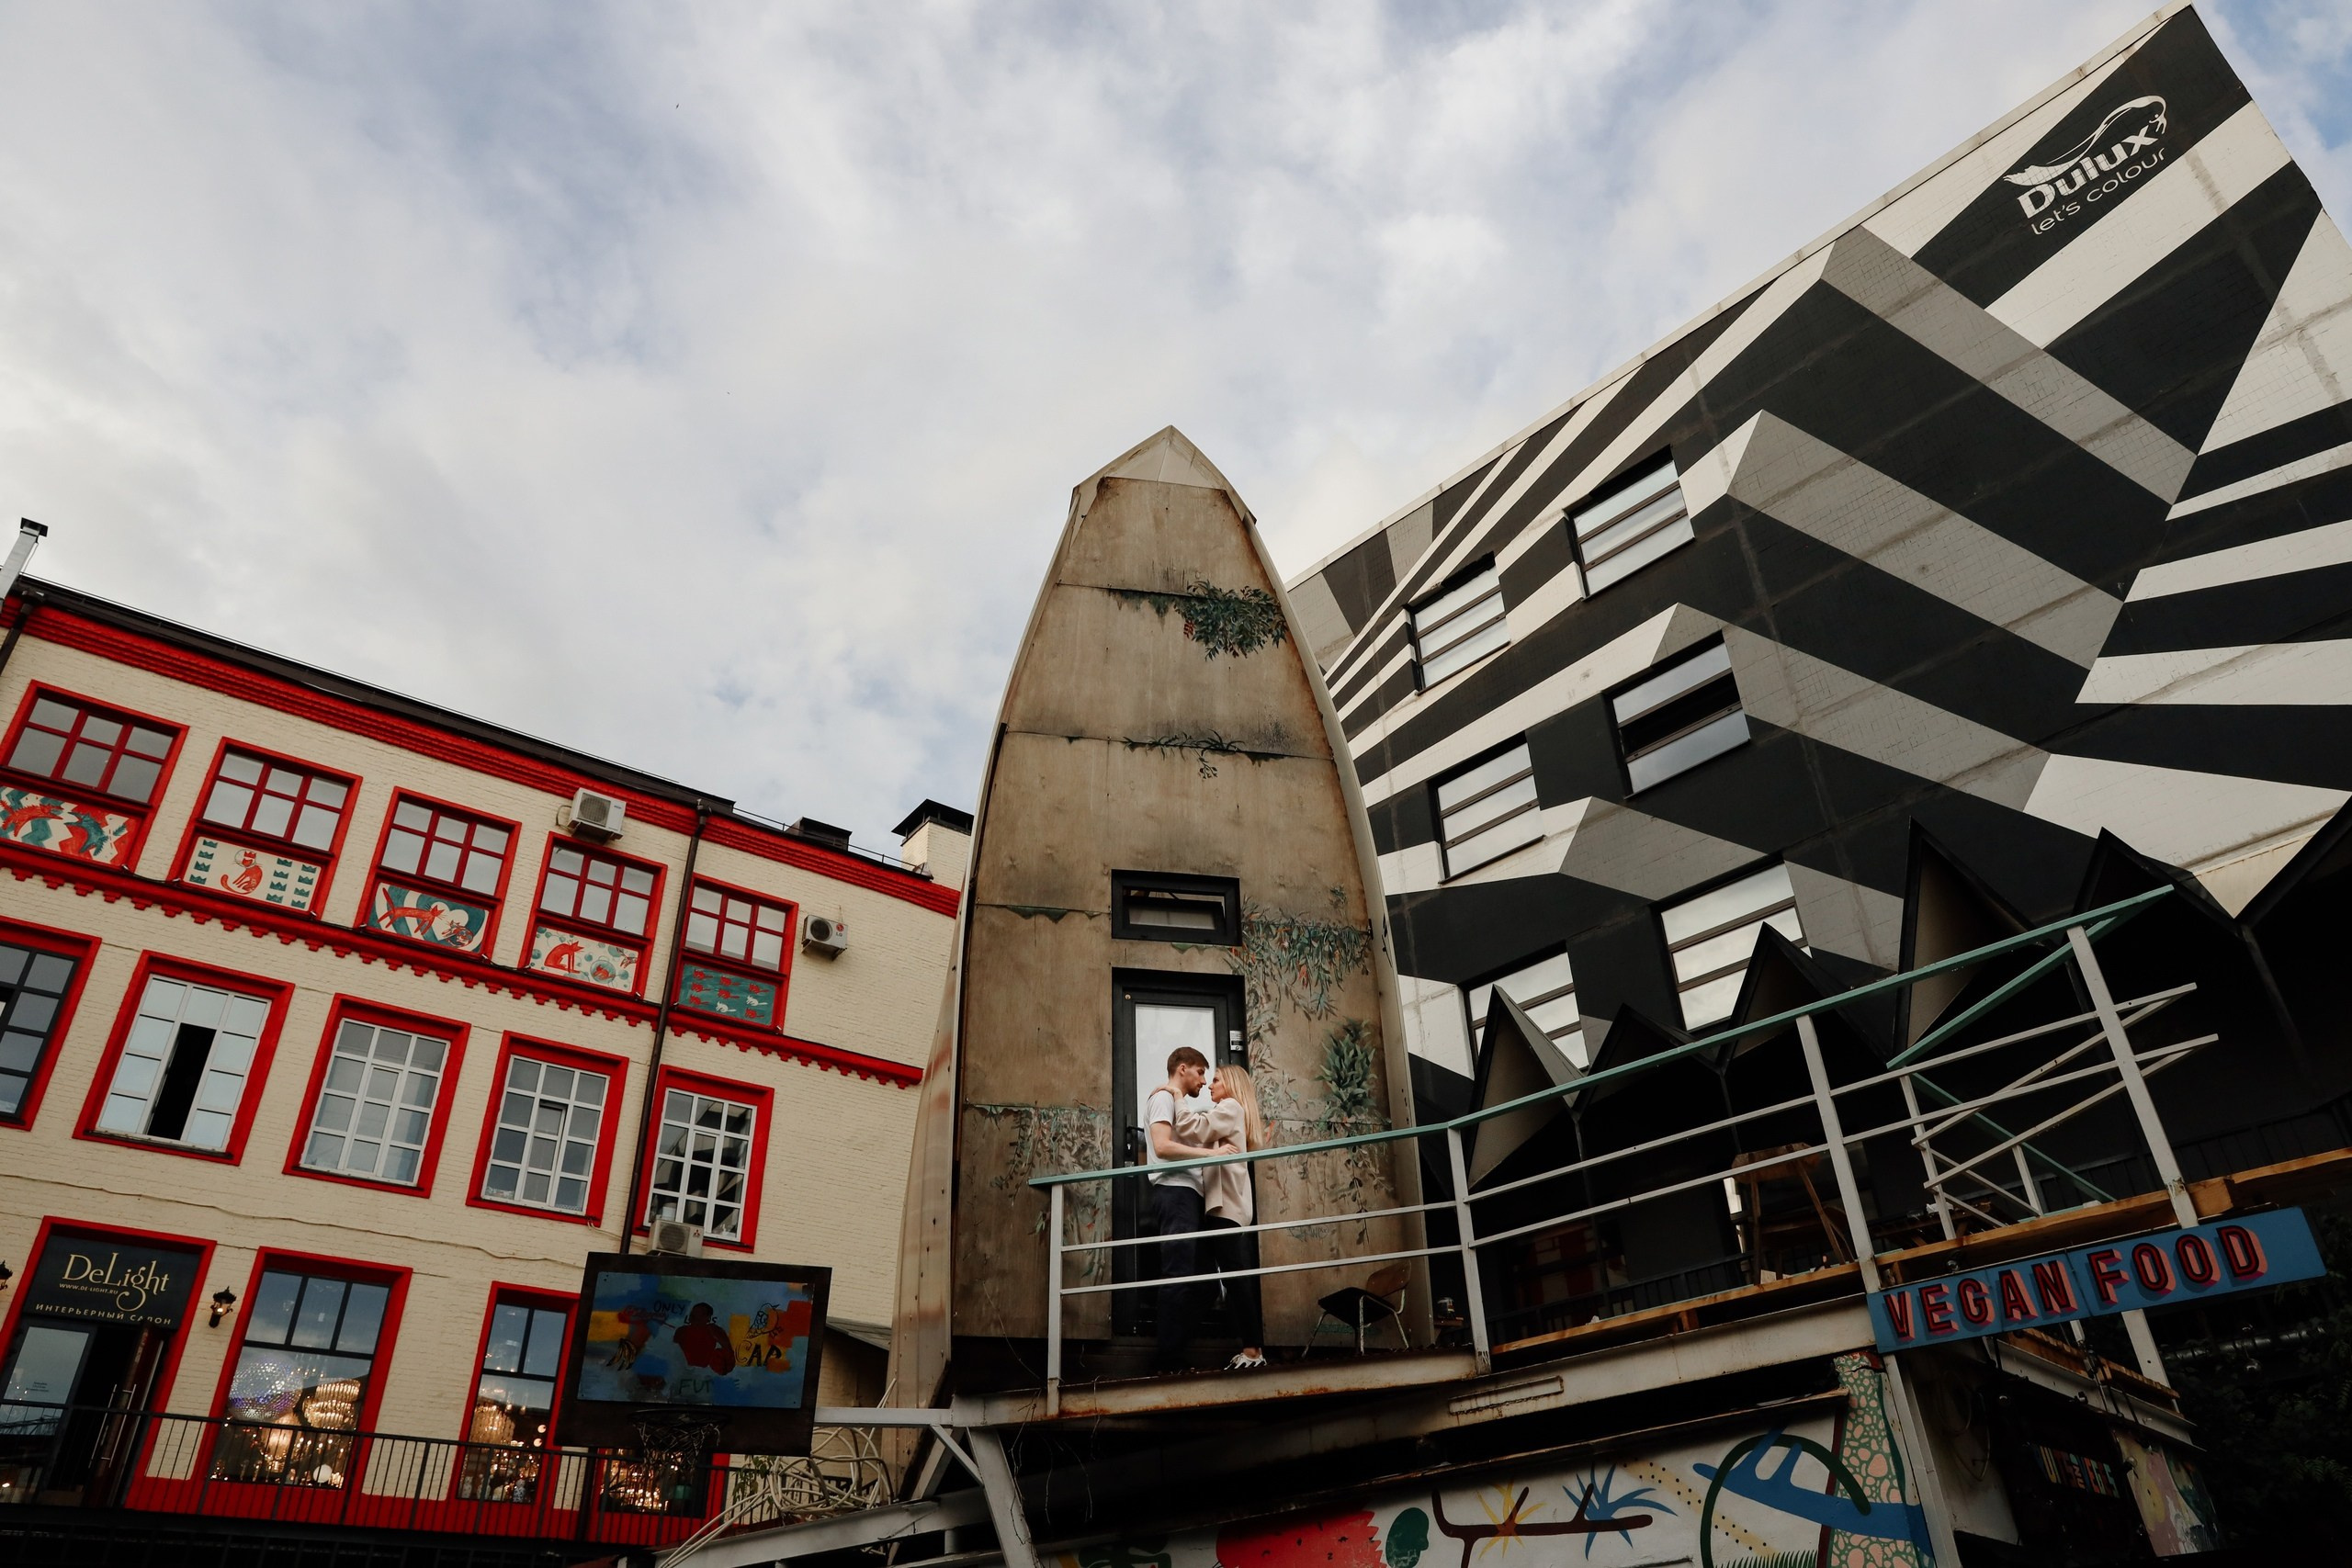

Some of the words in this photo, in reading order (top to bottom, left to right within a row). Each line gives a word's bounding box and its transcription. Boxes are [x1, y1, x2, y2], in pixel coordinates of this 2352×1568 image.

[2017, 124, 2159, 219] Dulux
[2031, 201, 2081, 235] let's
[2086, 147, 2165, 202] colour
[36, 1303, 125, 1320] ИНТЕРЬЕРНЫЙ
[130, 1314, 171, 1325] САЛОН
[62, 1252, 169, 1312] DeLight
[653, 1300, 685, 1316] ONLY
[1884, 1259, 2078, 1342] VEGAN
[2086, 1224, 2268, 1304] FOOD
